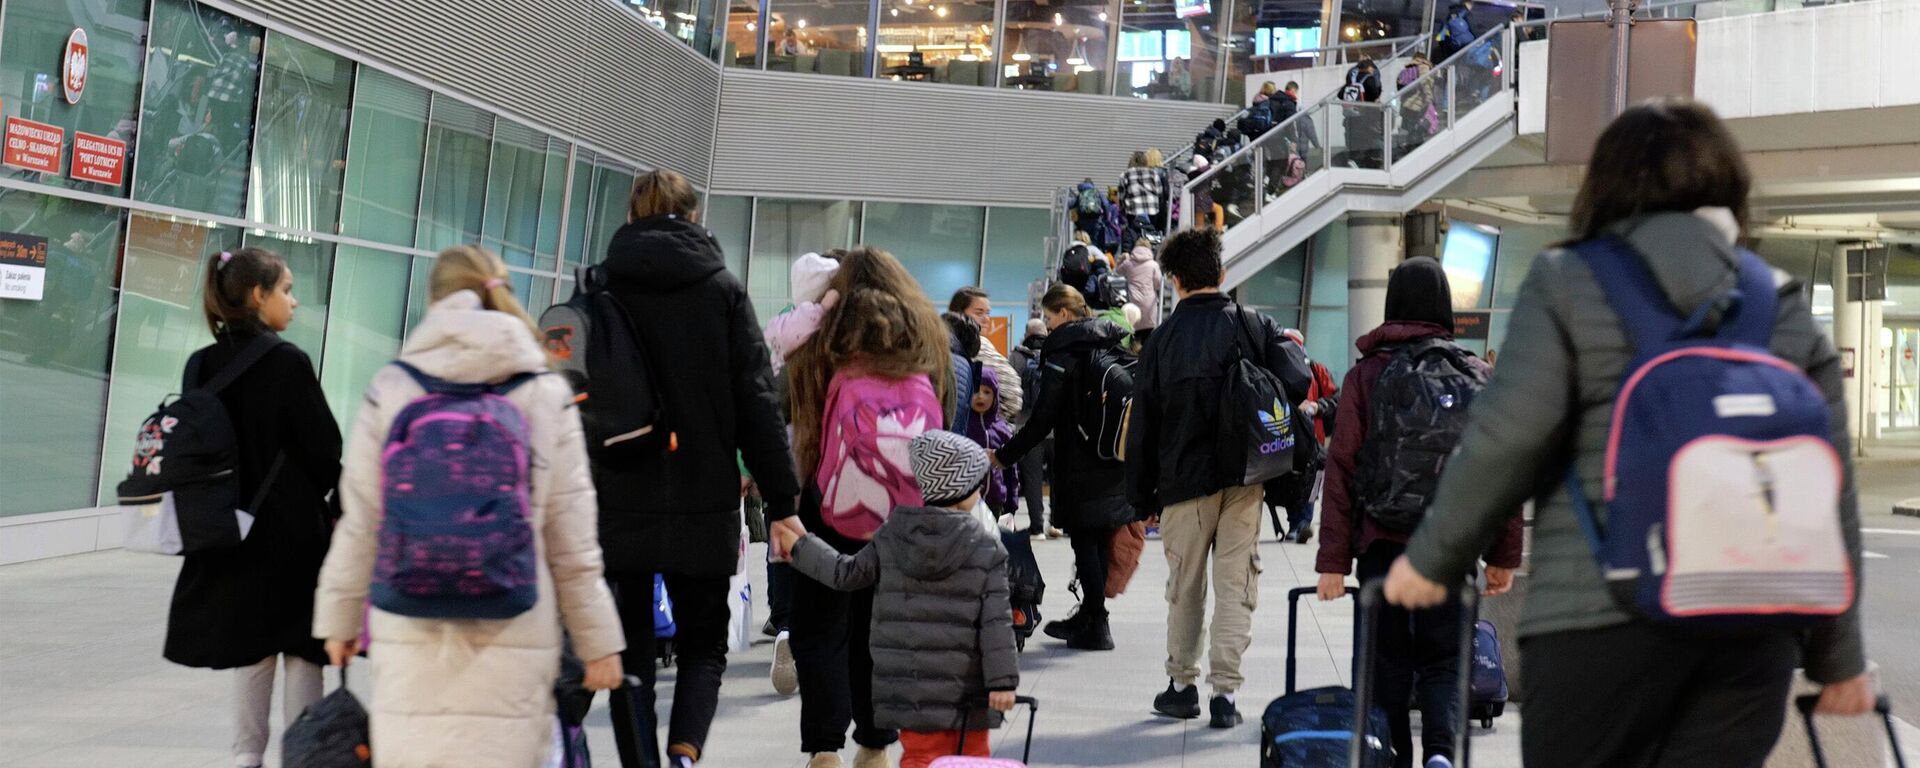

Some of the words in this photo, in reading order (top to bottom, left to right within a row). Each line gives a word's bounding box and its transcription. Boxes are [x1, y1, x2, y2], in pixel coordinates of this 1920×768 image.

[9, 137, 26, 150] CELNO
[77, 138, 108, 154] DELEGATURA
[22, 153, 49, 167] Warszawie
[88, 166, 113, 179] Warszawie
